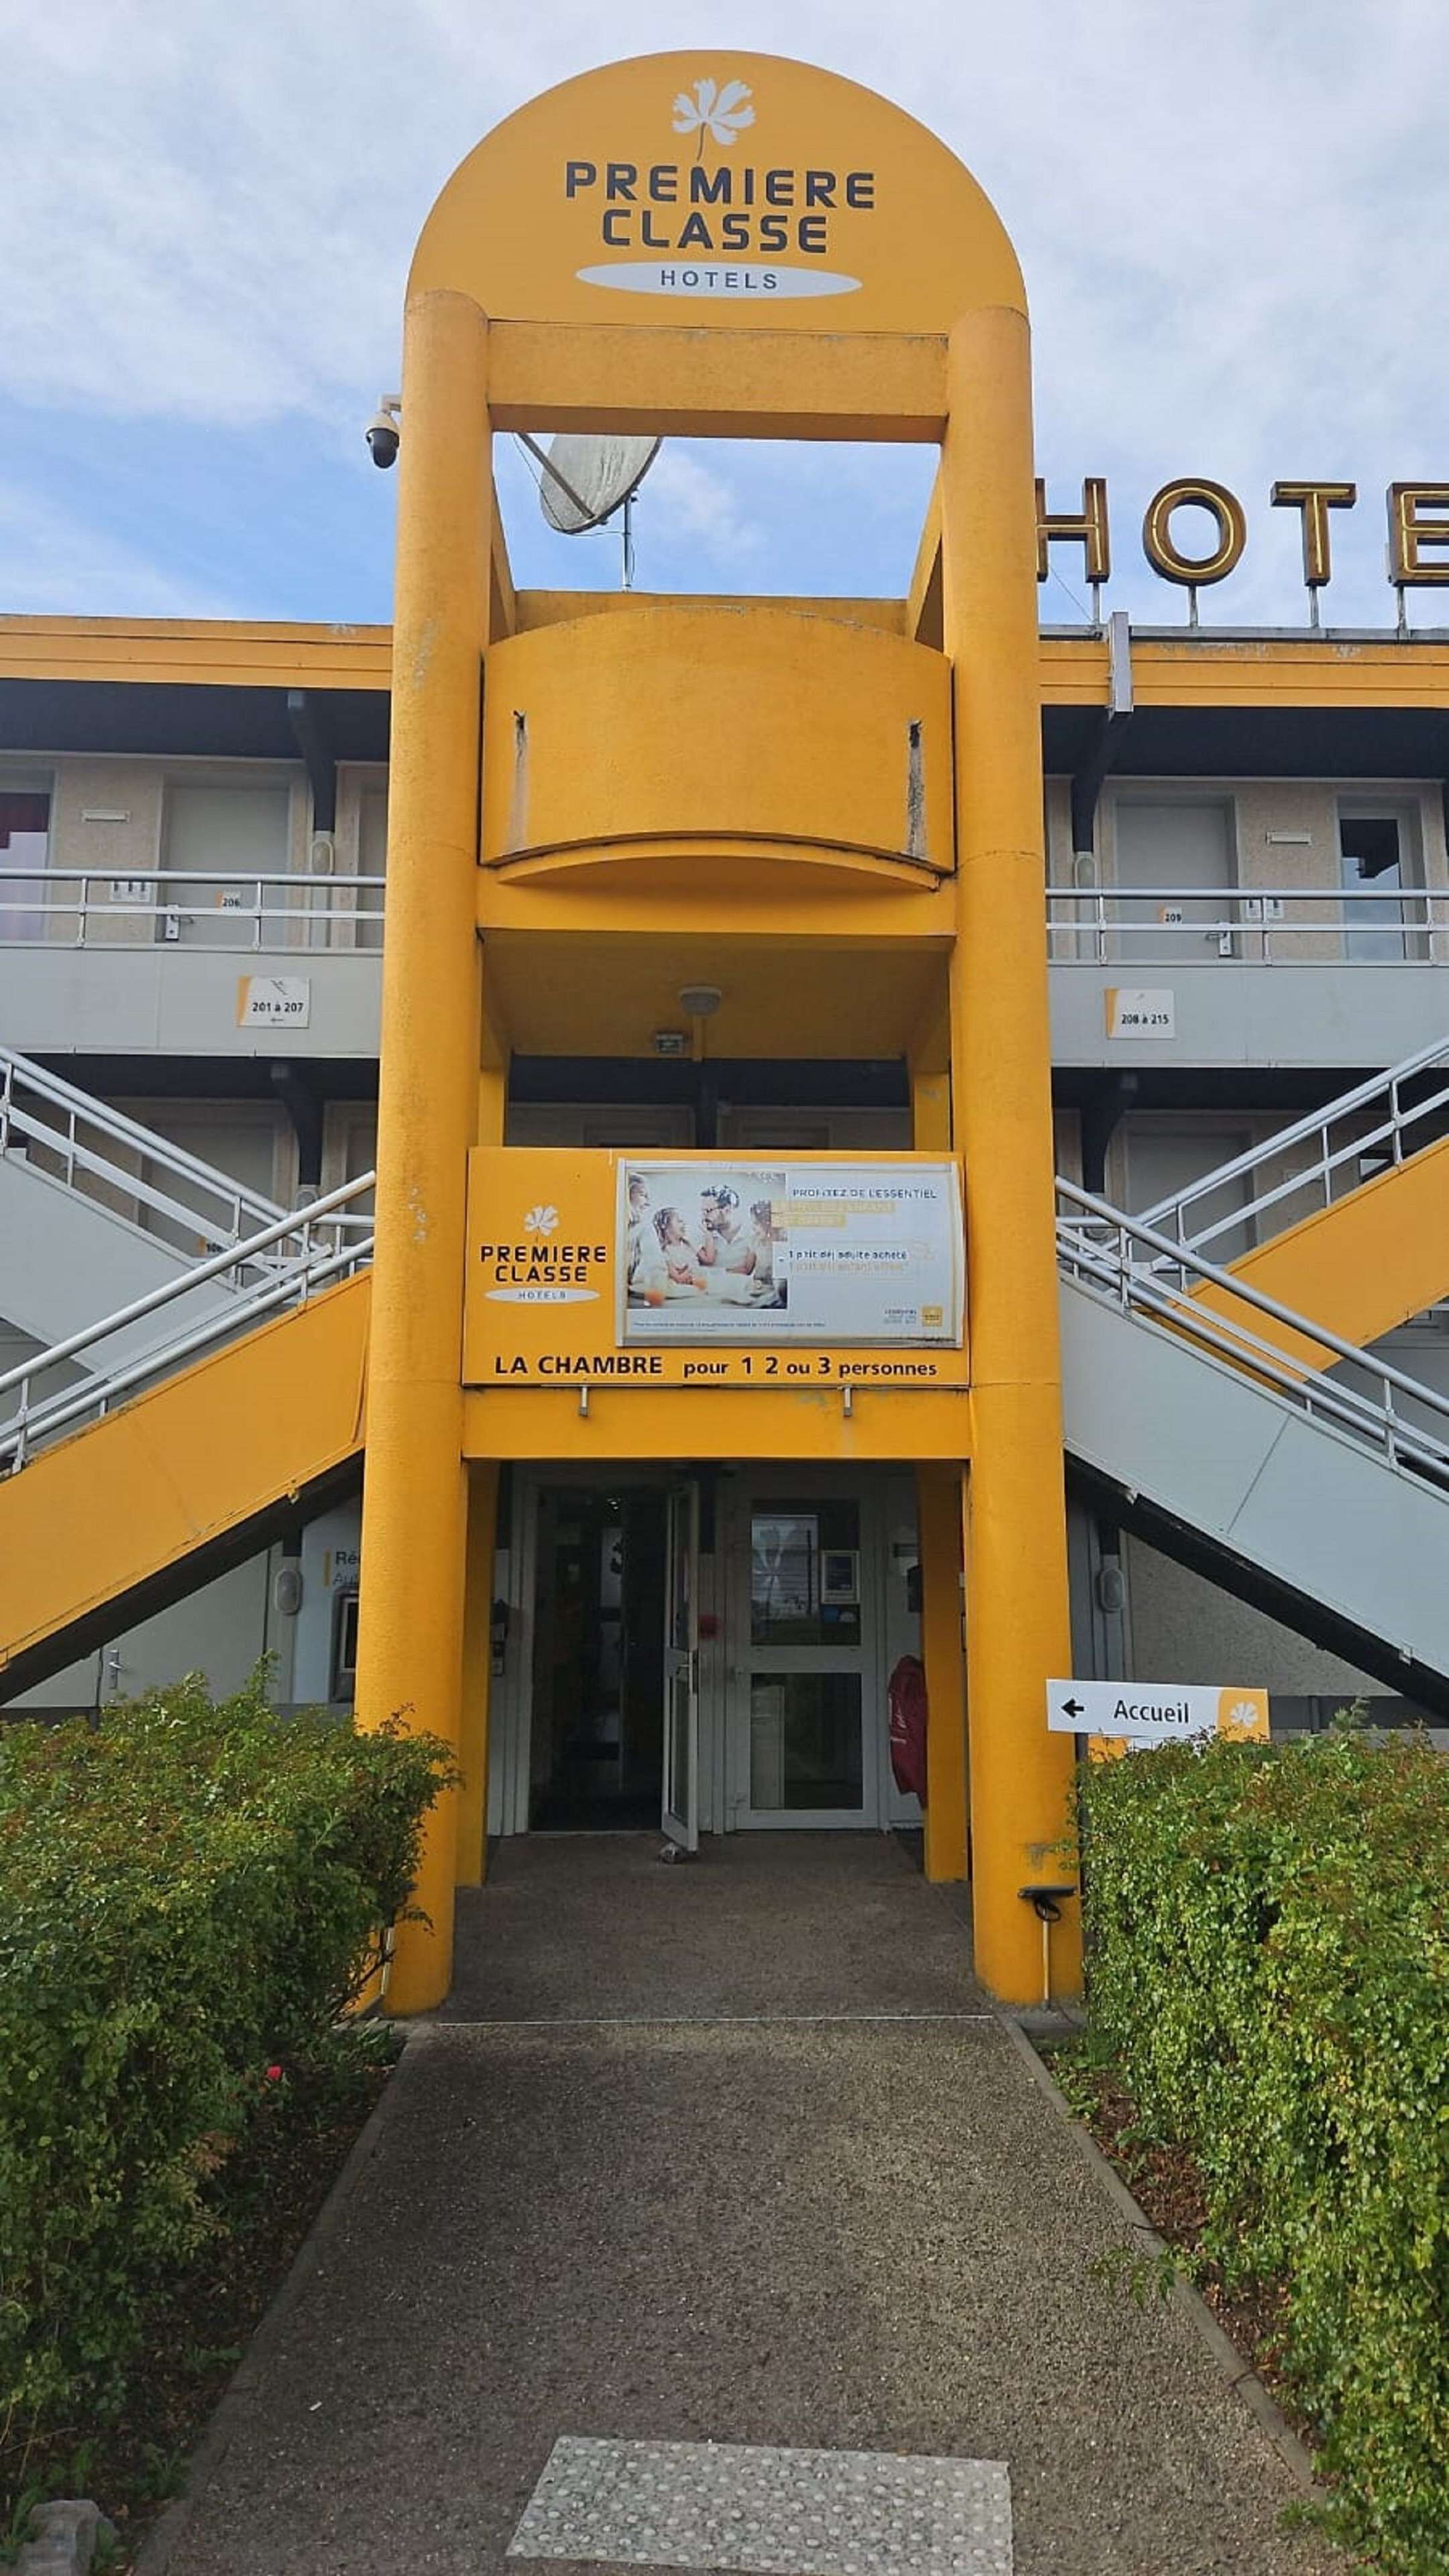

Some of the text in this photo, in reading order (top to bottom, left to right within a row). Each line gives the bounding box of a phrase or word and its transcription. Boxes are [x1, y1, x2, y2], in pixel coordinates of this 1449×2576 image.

[566, 161, 875, 209] PREMIERE
[602, 209, 826, 254] CLASSE
[660, 270, 778, 289] HOTELS
[1034, 477, 1449, 586] HOTE
[252, 1002, 271, 1012] 201
[284, 1002, 303, 1013] 207
[1122, 1014, 1138, 1025] 208
[1151, 1014, 1169, 1025] 215
[851, 1188, 865, 1198] DE
[480, 1245, 606, 1263] PREMIERE
[496, 1265, 588, 1282] CLASSE
[518, 1291, 566, 1300] HOTELS
[495, 1356, 937, 1378] LA CHAMBRE pour 1 2 ou 3 personnes
[335, 1550, 360, 1565] Ré
[1113, 1700, 1189, 1724] Accueil
